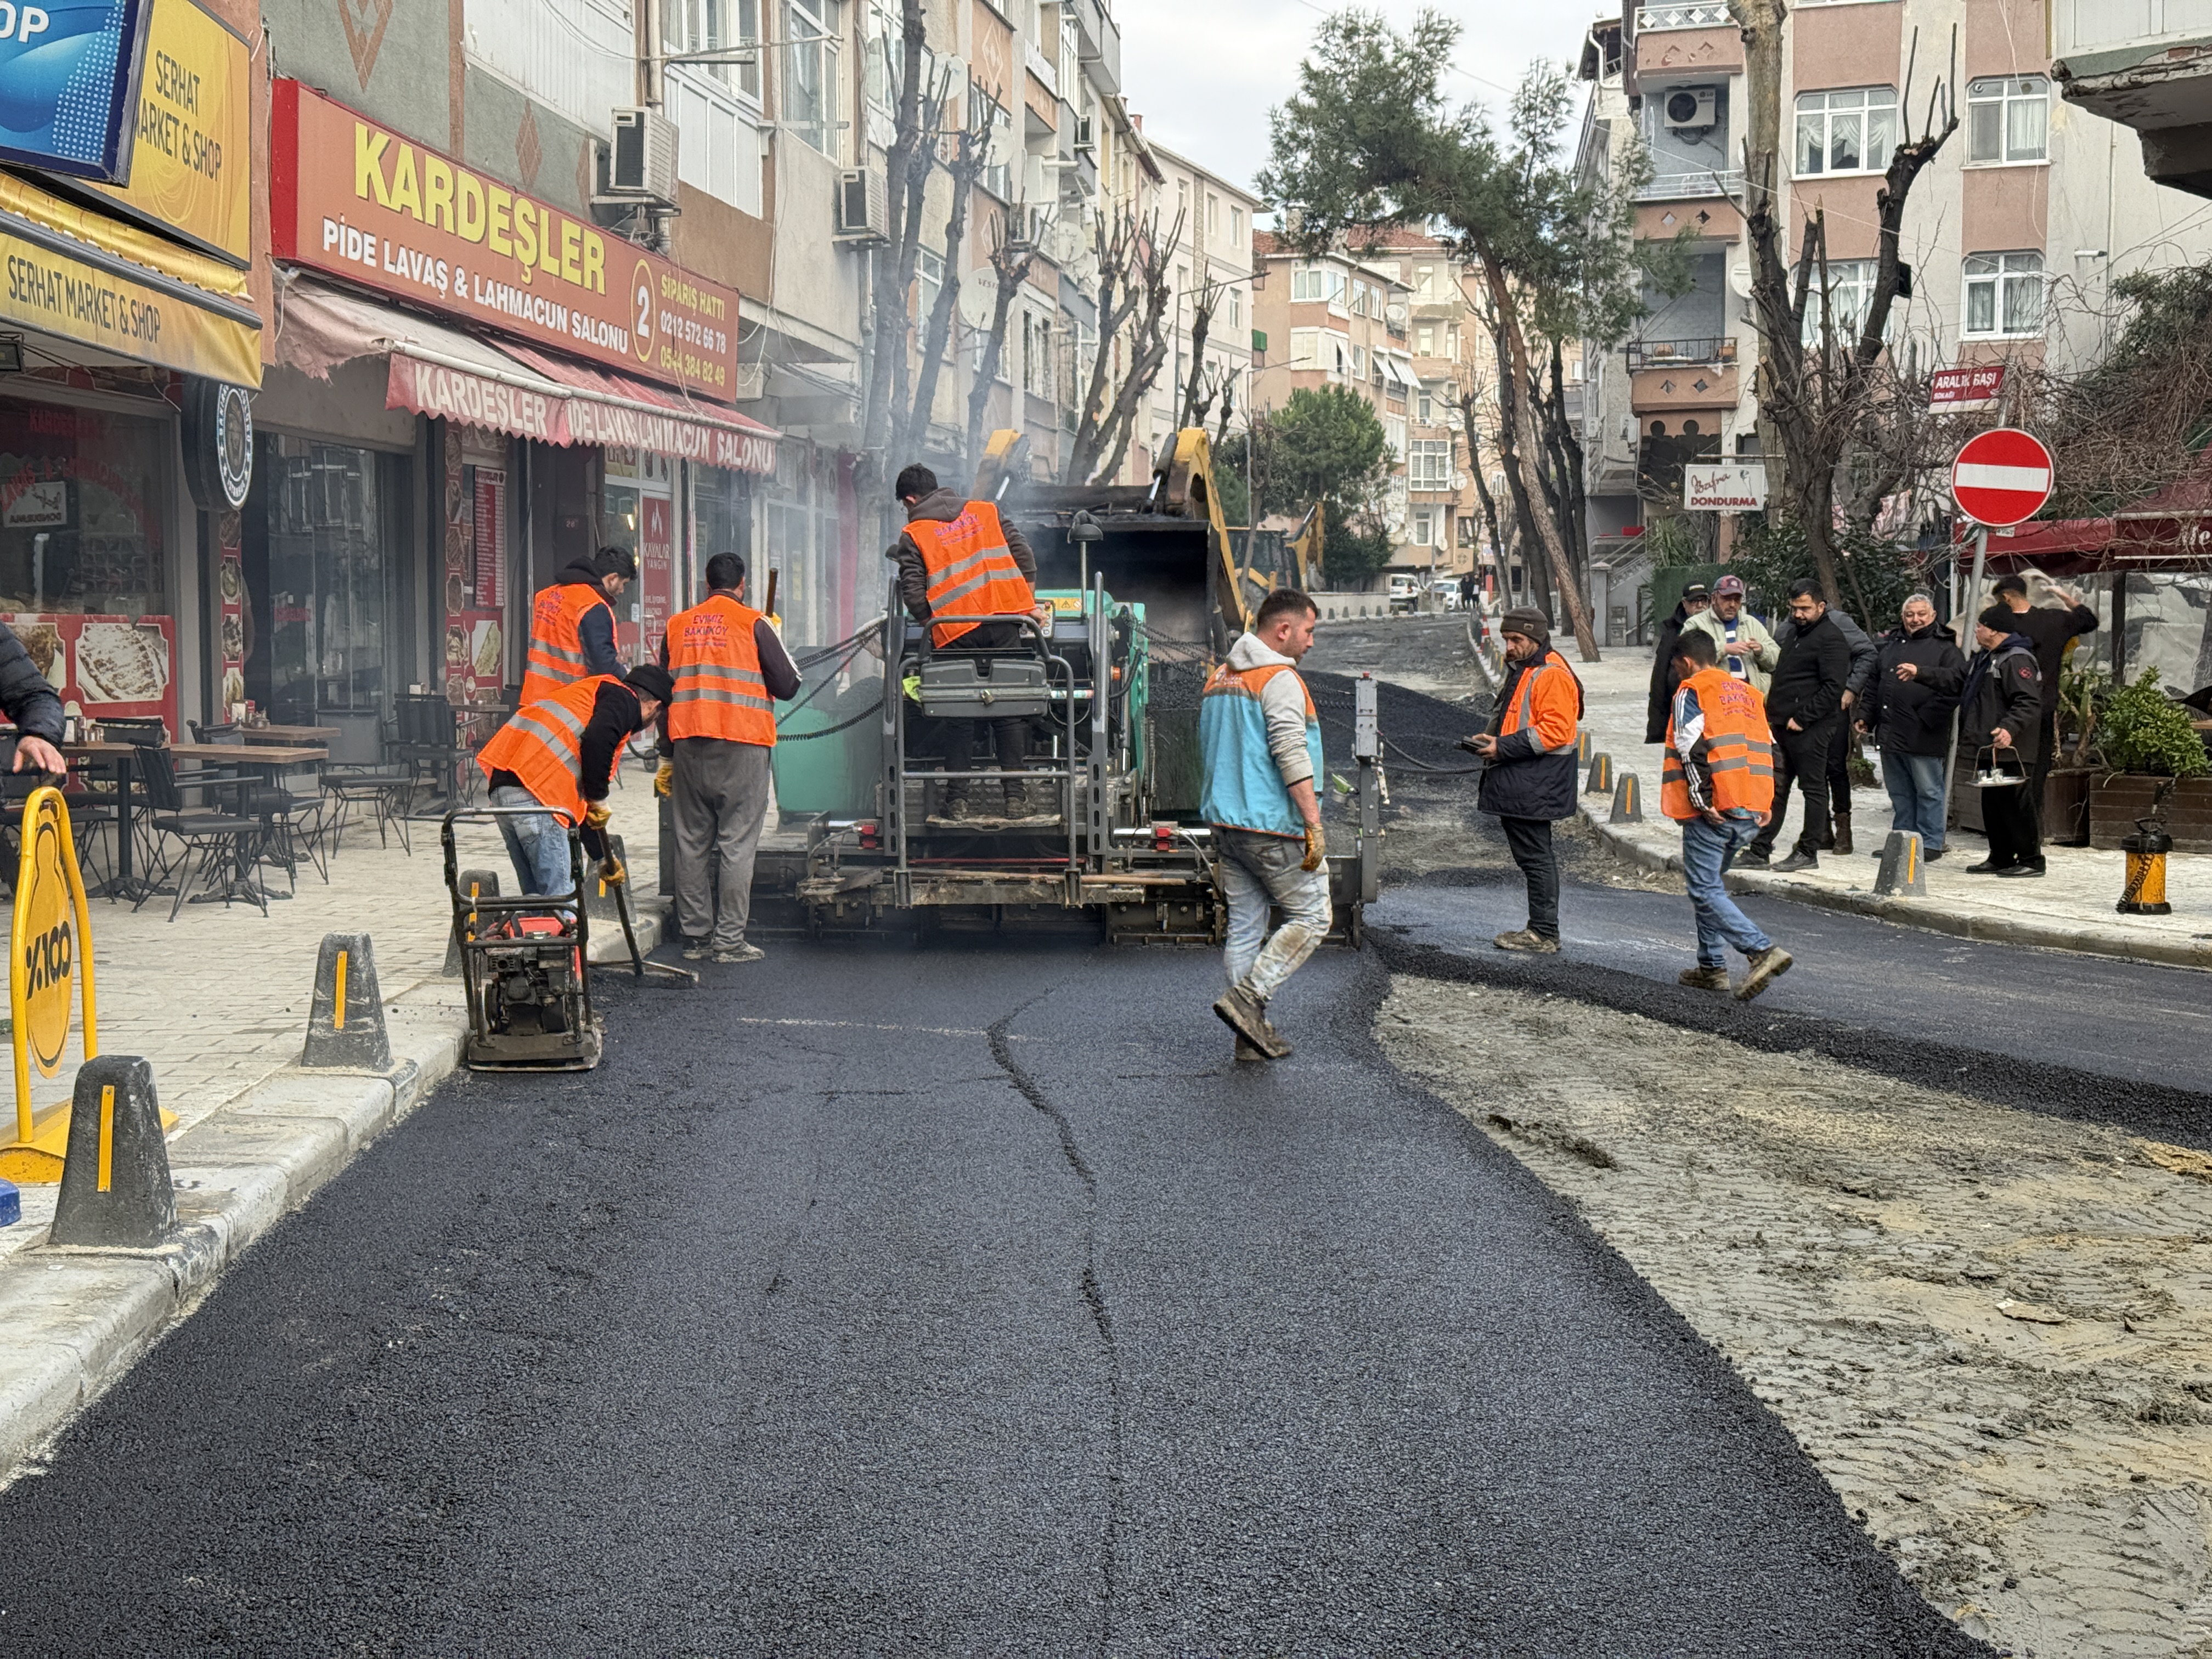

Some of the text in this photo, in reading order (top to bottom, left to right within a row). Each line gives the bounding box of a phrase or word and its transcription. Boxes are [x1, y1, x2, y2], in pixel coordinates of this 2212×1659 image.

[156, 50, 200, 117] SERHAT
[137, 98, 222, 182] ARKET & SHOP
[356, 122, 606, 297] KARDEŞLER
[8, 255, 160, 343] SERHAT MARKET & SHOP
[323, 213, 628, 354] PİDE LAVAŞ & LAHMACUN SALONU
[661, 270, 725, 321] SİPARİŞ HATTI
[978, 278, 998, 290] VEST
[637, 285, 650, 338] 2
[661, 309, 726, 354] 0212 572 66 78
[685, 354, 701, 379] 384
[702, 360, 713, 383] 82
[715, 365, 725, 387] 49
[1936, 372, 1997, 390] ARALIK BAŞI
[415, 363, 548, 437] KARDEŞLER
[717, 432, 774, 471] SALONU
[1691, 496, 1758, 506] DONDURMA
[643, 542, 670, 560] KAYALAR
[26, 921, 71, 1001] %100
